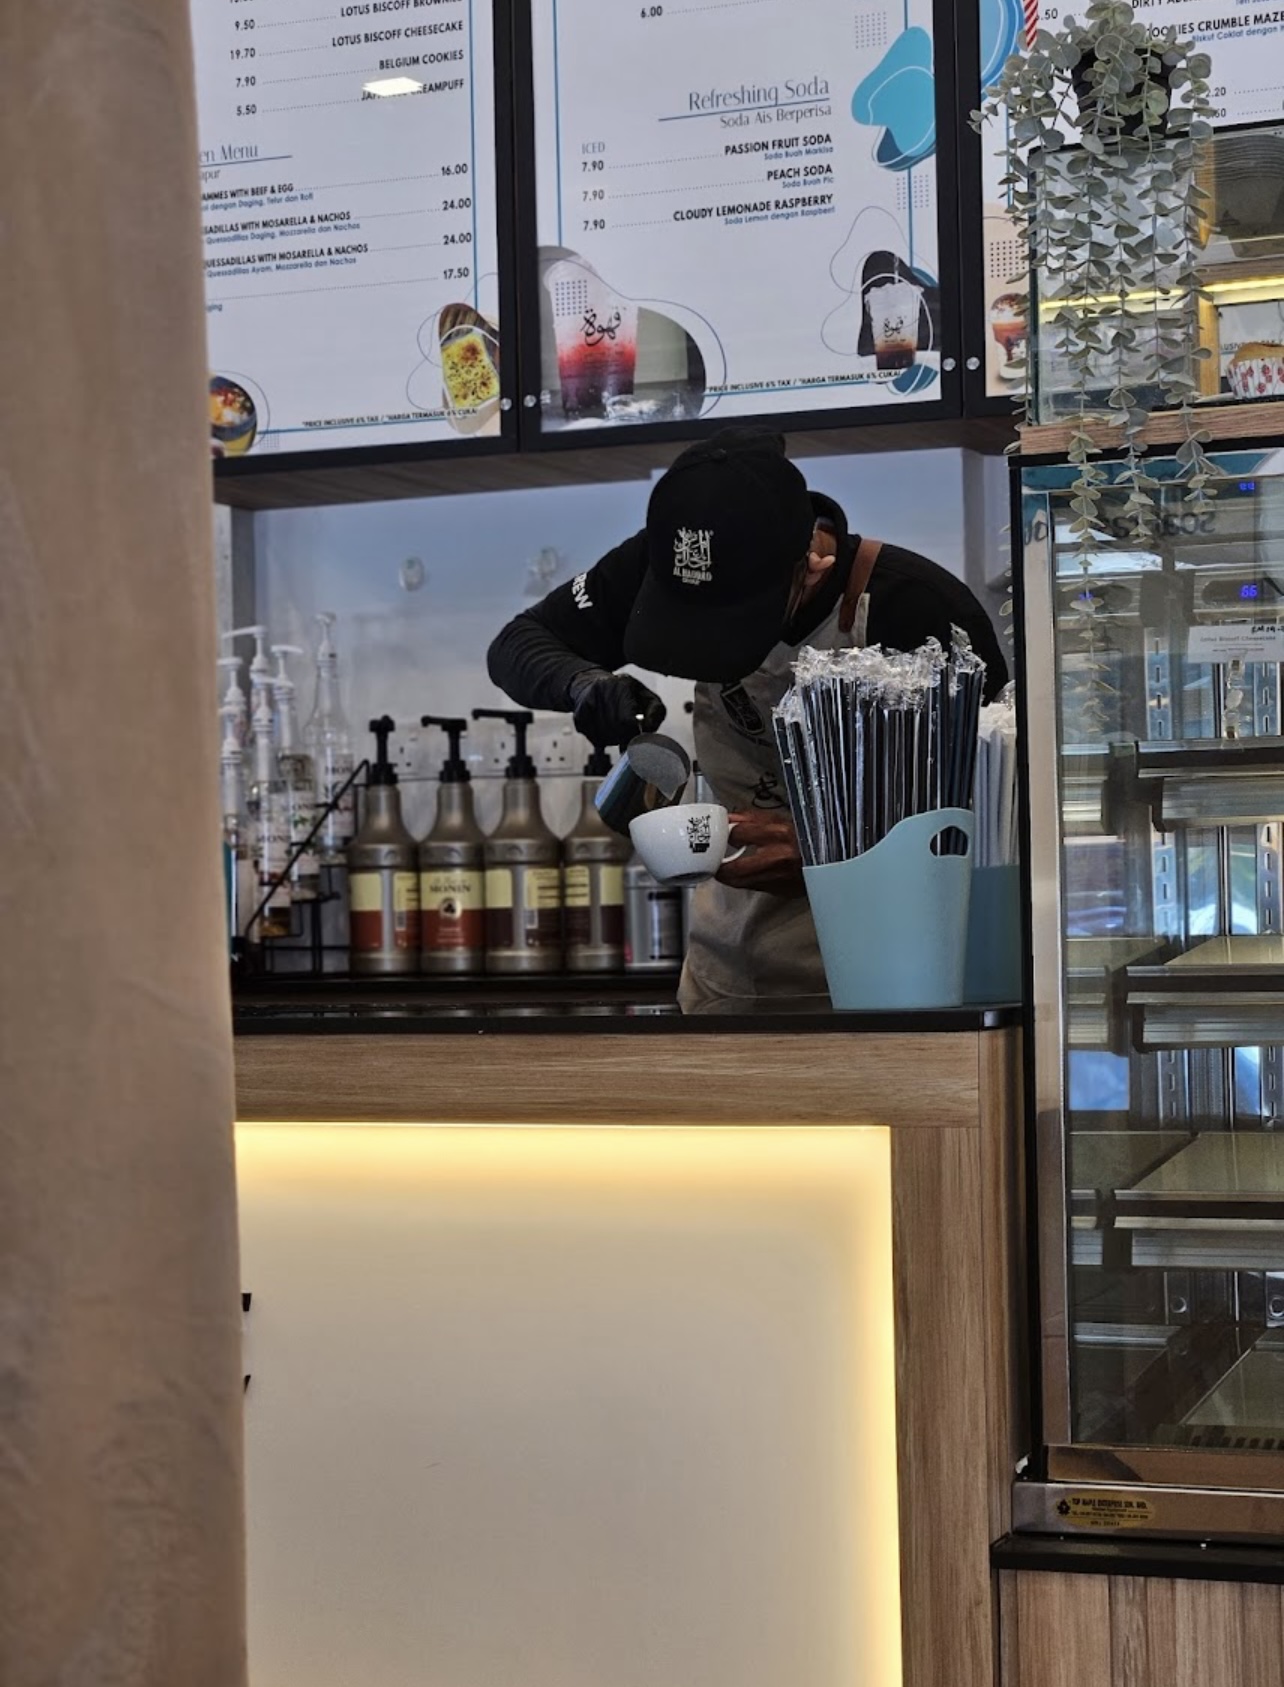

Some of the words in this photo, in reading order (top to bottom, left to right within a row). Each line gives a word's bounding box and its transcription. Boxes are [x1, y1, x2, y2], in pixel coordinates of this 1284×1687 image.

[340, 4, 370, 17] LOTUS
[373, 0, 410, 14] BISCOFF
[640, 5, 663, 18] 6.00
[1036, 8, 1059, 20] .50
[235, 19, 255, 31] 9.50
[1198, 15, 1250, 32] CRUMBLE
[332, 34, 361, 47] LOTUS
[364, 28, 402, 43] BISCOFF
[404, 20, 463, 38] CHEESECAKE
[1217, 30, 1244, 40] Coklat
[1246, 26, 1278, 37] dengan
[230, 47, 256, 60] 19.70
[379, 56, 420, 70] BELGIUM
[422, 50, 464, 64] COOKIES
[236, 75, 256, 88] 7.90
[689, 85, 779, 111] Refreshing
[784, 75, 830, 99] Soda
[236, 104, 257, 117] 5.50
[720, 111, 750, 128] Soda
[754, 109, 773, 124] Ais
[776, 104, 832, 123] Berperisa
[581, 141, 606, 154] ICED
[725, 141, 769, 155] PASSION
[772, 136, 800, 150] FRUIT
[803, 133, 832, 146] SODA
[221, 144, 259, 161] Menu
[764, 152, 783, 160] Soda
[785, 149, 803, 158] Buah
[805, 146, 834, 156] Markisa
[441, 163, 468, 176] 16.00
[581, 160, 604, 172] 7.90
[767, 167, 801, 181] PEACH
[803, 164, 833, 177] SODA
[229, 188, 250, 199] WITH
[251, 186, 268, 197] BEEF
[270, 184, 276, 194] &
[278, 183, 294, 193] EGG
[782, 180, 801, 188] Soda
[582, 189, 605, 201] 7.90
[442, 197, 471, 211] 24.00
[673, 207, 714, 221] CLOUDY
[716, 201, 771, 217] LEMONADE
[775, 193, 834, 210] RASPBERRY
[241, 220, 260, 231] WITH
[262, 216, 308, 229] MOSARELLA
[310, 214, 315, 224] &
[318, 211, 351, 223] NACHOS
[583, 218, 606, 231] 7.90
[724, 217, 743, 225] Soda
[745, 213, 768, 223] Lemon
[770, 210, 799, 221] dengan
[318, 225, 332, 234] dan
[334, 222, 360, 231] Nachos
[443, 232, 472, 245] 24.00
[258, 252, 277, 263] WITH
[279, 248, 324, 261] MOSARELLA
[327, 246, 332, 256] &
[334, 243, 369, 255] NACHOS
[314, 259, 328, 268] dan
[330, 257, 356, 266] Nachos
[443, 267, 469, 280] 17.50
[730, 382, 764, 391] INCLUSIVE
[778, 379, 791, 387] TAX
[827, 373, 864, 383] TERMASUK
